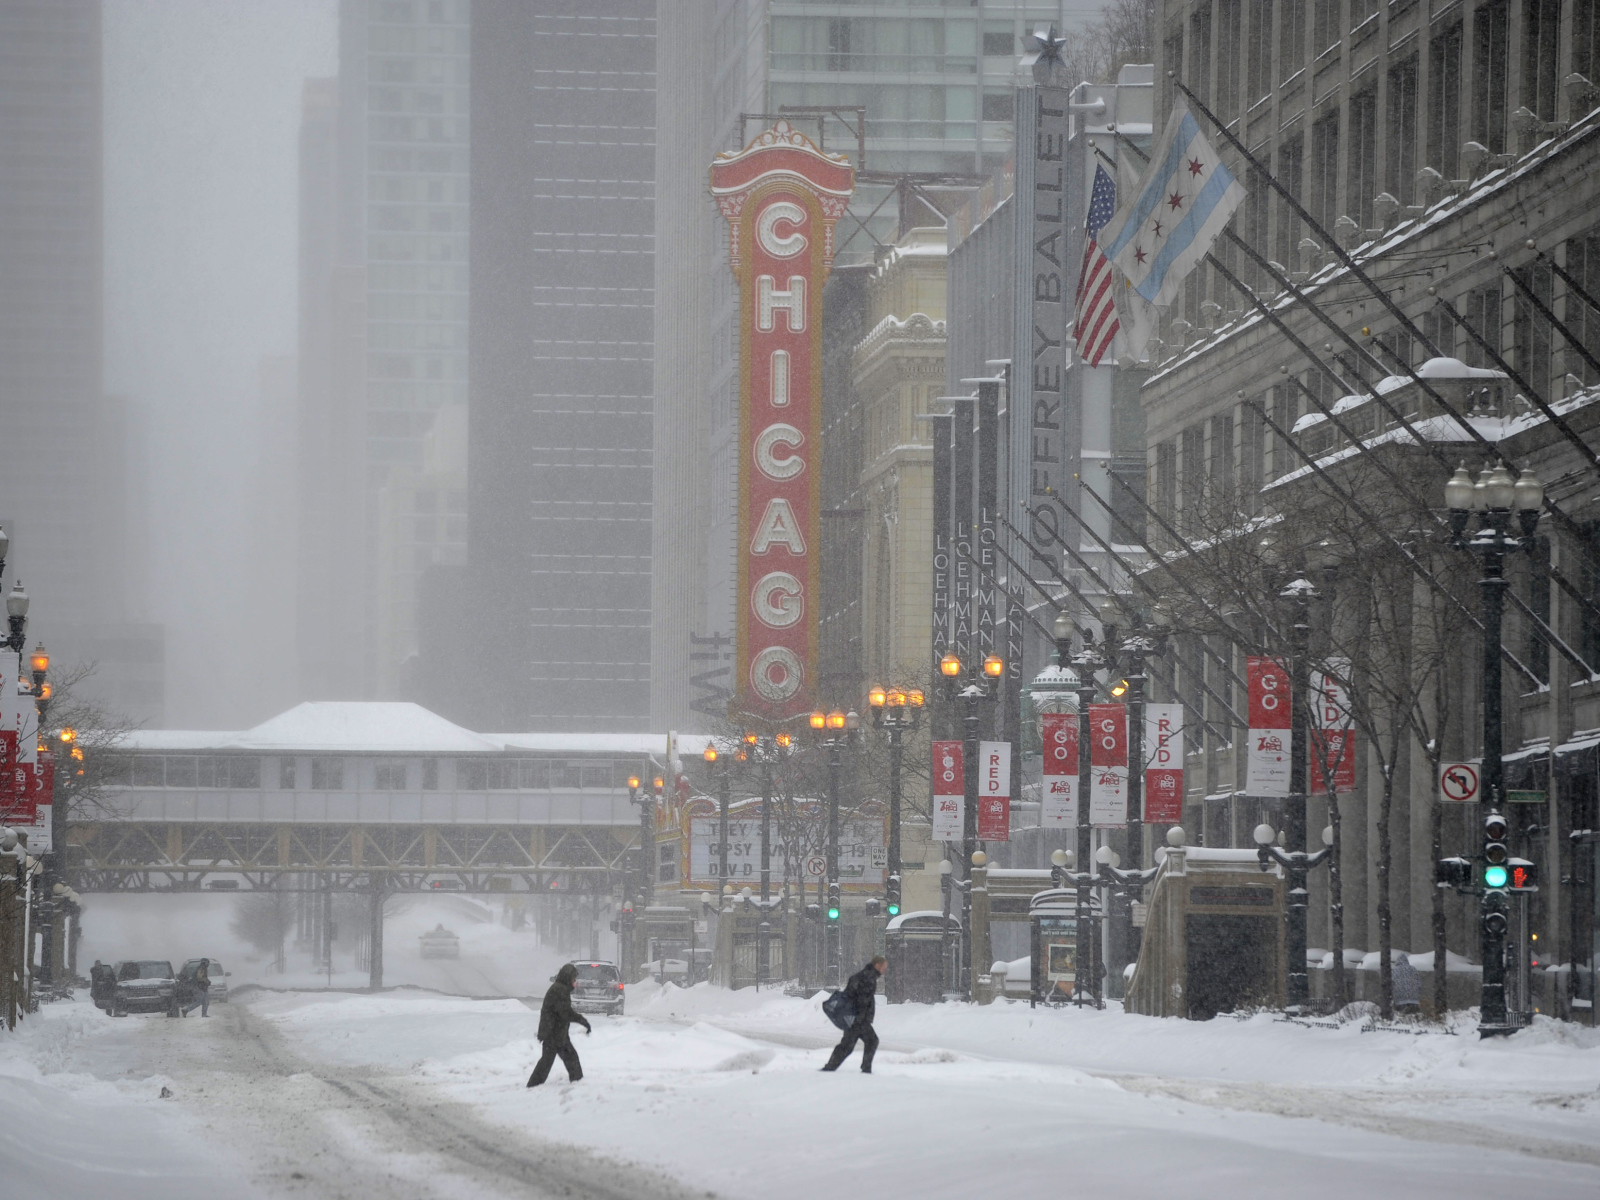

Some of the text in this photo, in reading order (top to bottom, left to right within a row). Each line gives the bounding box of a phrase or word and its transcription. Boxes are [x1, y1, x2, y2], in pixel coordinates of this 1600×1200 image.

[1031, 94, 1065, 580] JOFFREY BALLET
[751, 201, 808, 702] CHICAGO
[1261, 674, 1279, 711] GO
[1053, 730, 1068, 760] GO
[1101, 718, 1116, 750] GO
[1158, 718, 1171, 763] RED
[988, 754, 1000, 792] RED
[709, 823, 748, 836] TEY
